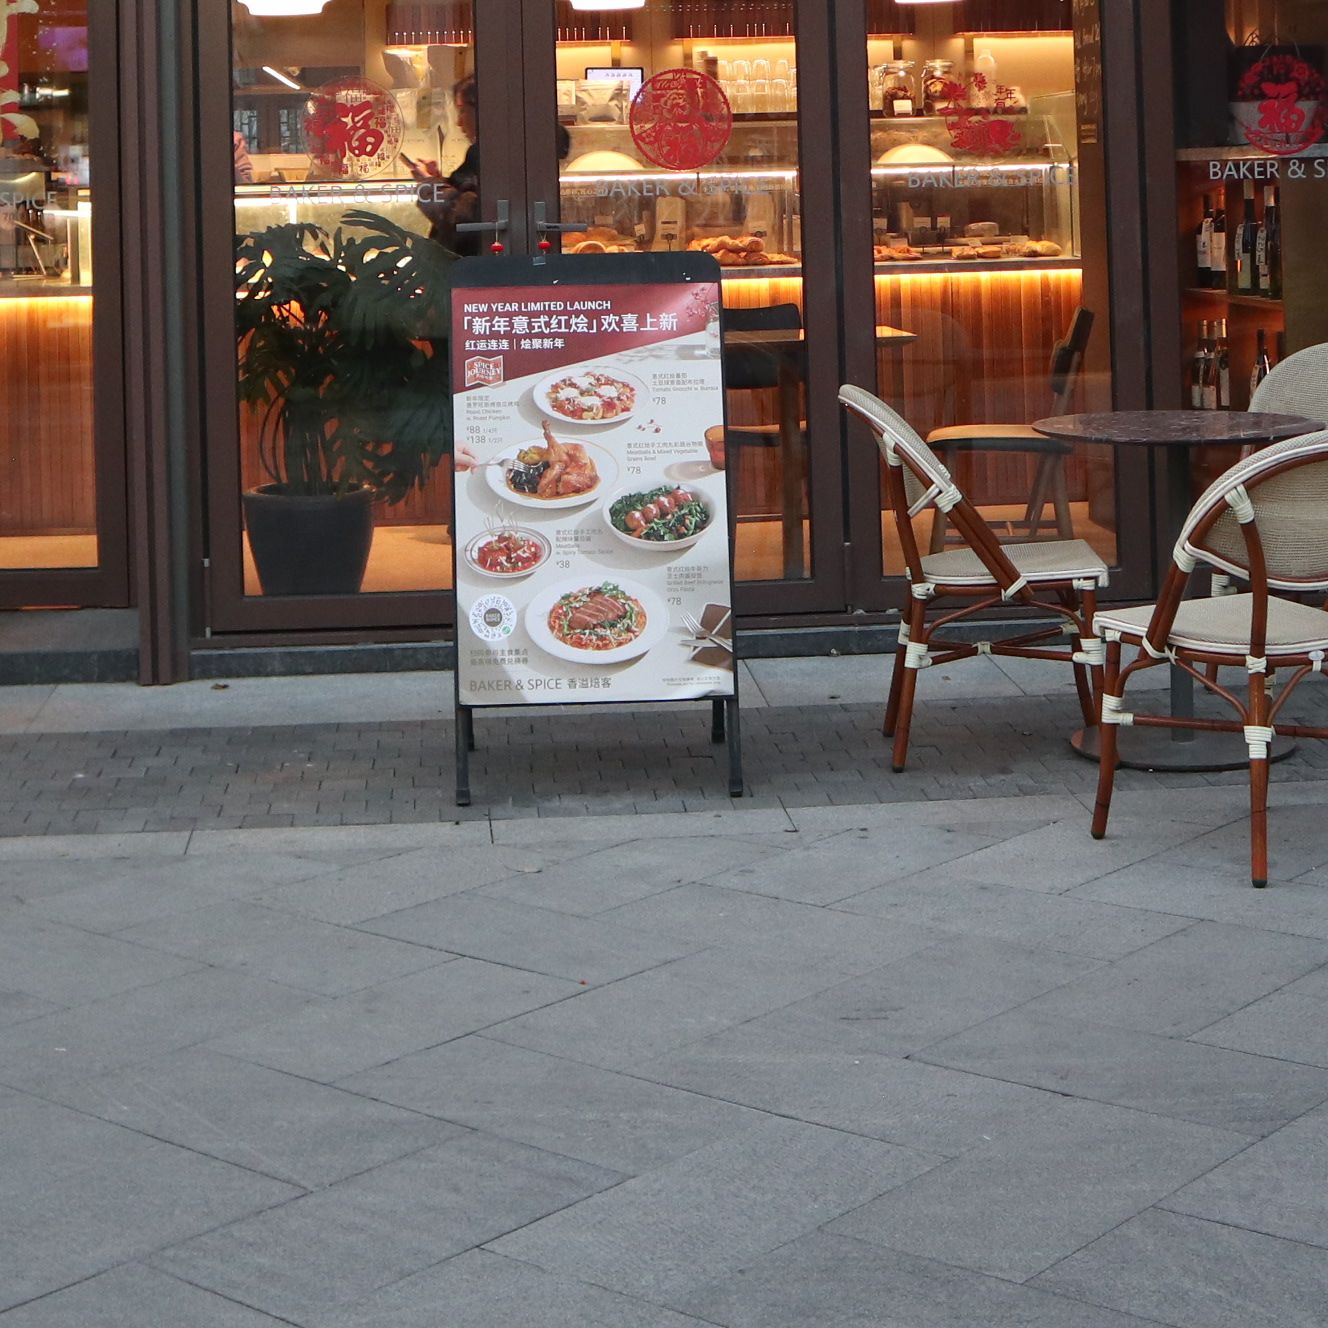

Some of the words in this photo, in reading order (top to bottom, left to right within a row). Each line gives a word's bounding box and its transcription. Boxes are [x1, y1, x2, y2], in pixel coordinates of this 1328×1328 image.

[908, 169, 981, 189] BAKER
[1209, 161, 1280, 180] BAKER
[1287, 159, 1307, 178] &
[270, 185, 344, 205] BAKER
[354, 183, 374, 204] &
[381, 183, 445, 203] SPICE
[596, 178, 671, 197] BAKER
[678, 177, 698, 195] &
[0, 191, 58, 210] SPICE
[463, 302, 490, 313] NEW
[490, 302, 519, 312] YEAR
[521, 301, 565, 312] LIMITED
[566, 300, 611, 311] LAUNCH
[520, 338, 565, 350] 烩聚新年
[626, 466, 641, 475] ¥78
[470, 680, 512, 692] BAKER
[515, 679, 524, 691] &
[527, 678, 562, 690] SPICE
